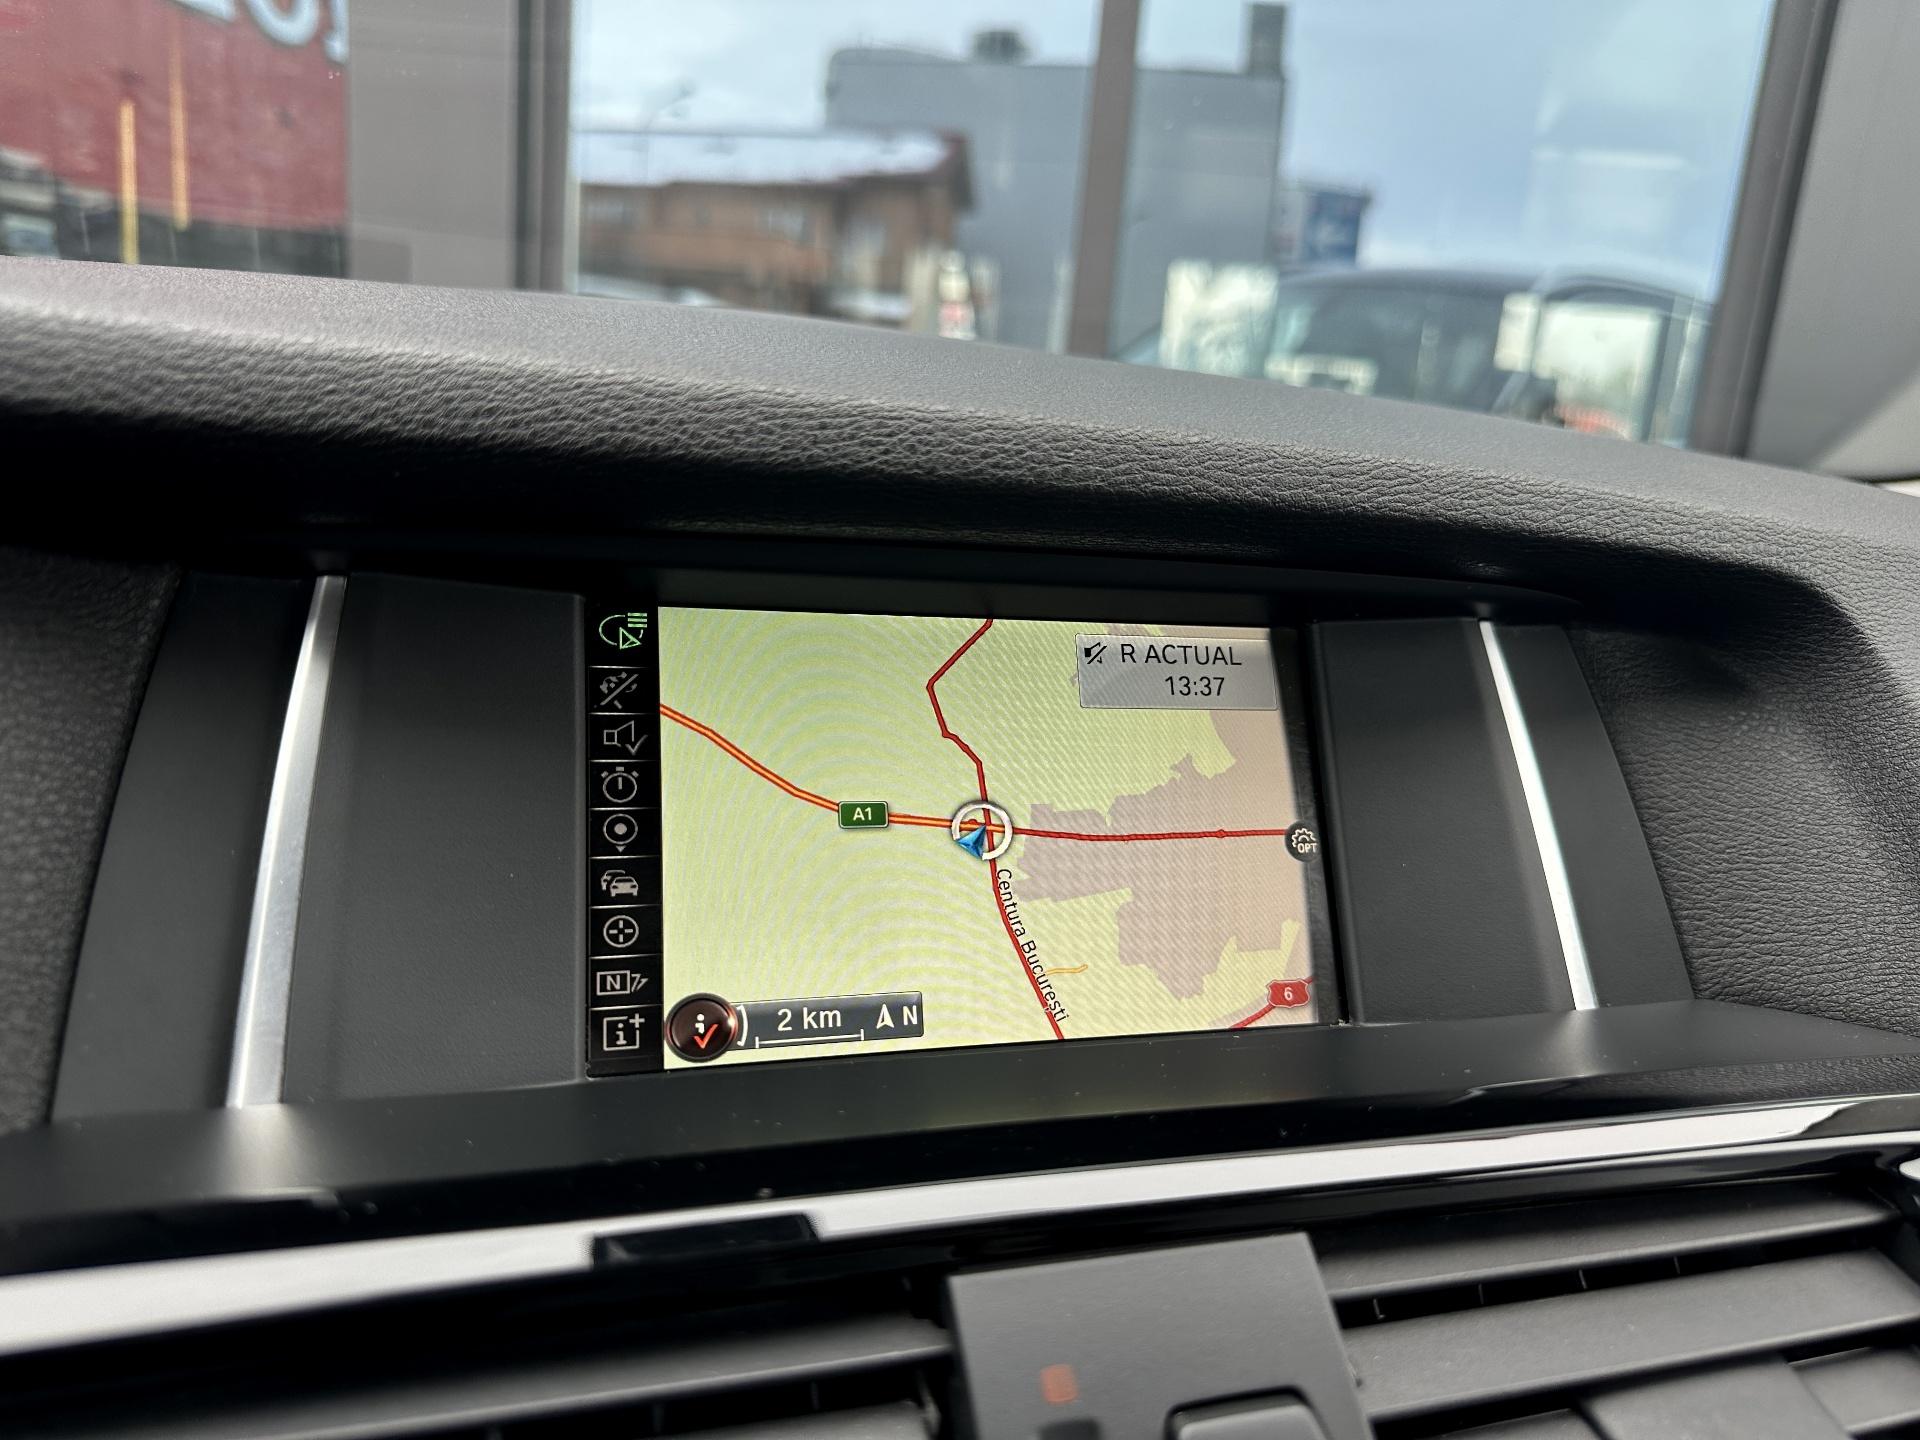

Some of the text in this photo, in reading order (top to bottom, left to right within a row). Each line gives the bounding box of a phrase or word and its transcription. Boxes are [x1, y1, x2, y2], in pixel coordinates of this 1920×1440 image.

[1120, 643, 1242, 666] R ACTUAL
[1164, 675, 1226, 697] 13:37
[852, 806, 873, 822] A1
[1297, 842, 1318, 854] OPT
[996, 868, 1026, 938] Centura
[1283, 985, 1294, 1002] 6
[777, 1007, 842, 1032] 2 km
[902, 1005, 918, 1026] N
